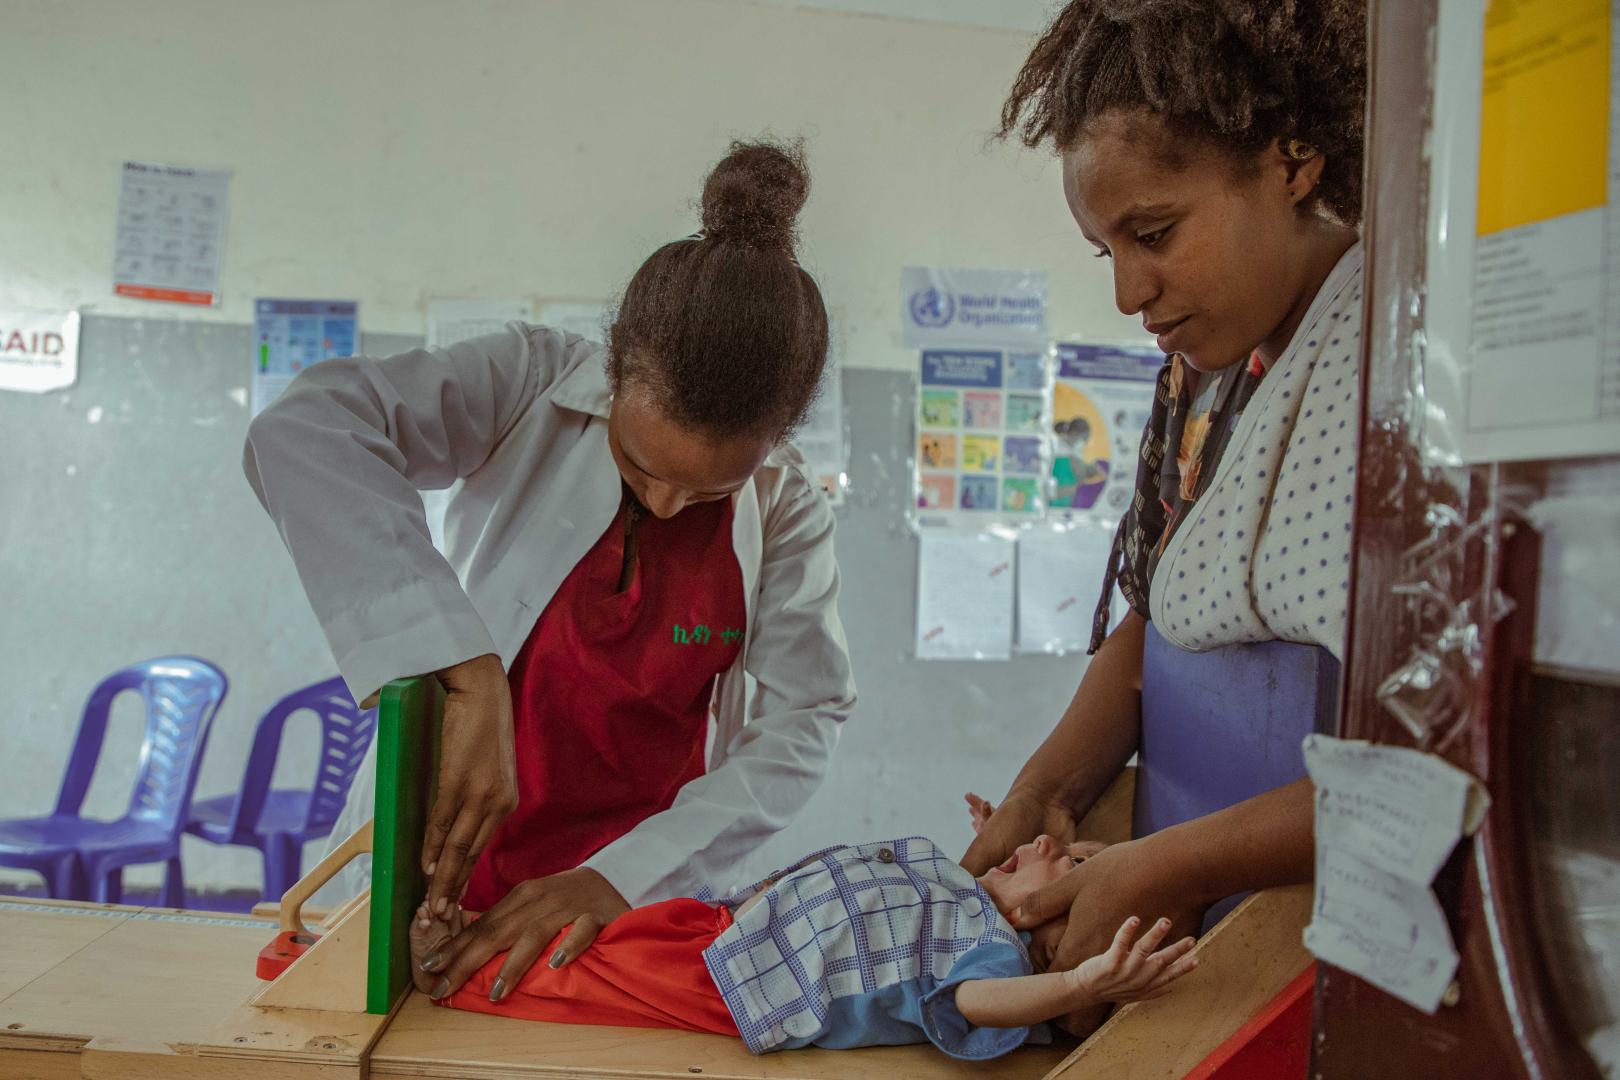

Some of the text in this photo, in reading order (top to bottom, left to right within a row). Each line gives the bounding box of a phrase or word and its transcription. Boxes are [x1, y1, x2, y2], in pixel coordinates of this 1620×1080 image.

[959, 295, 1041, 309] World Health
[0, 328, 65, 355] AID
